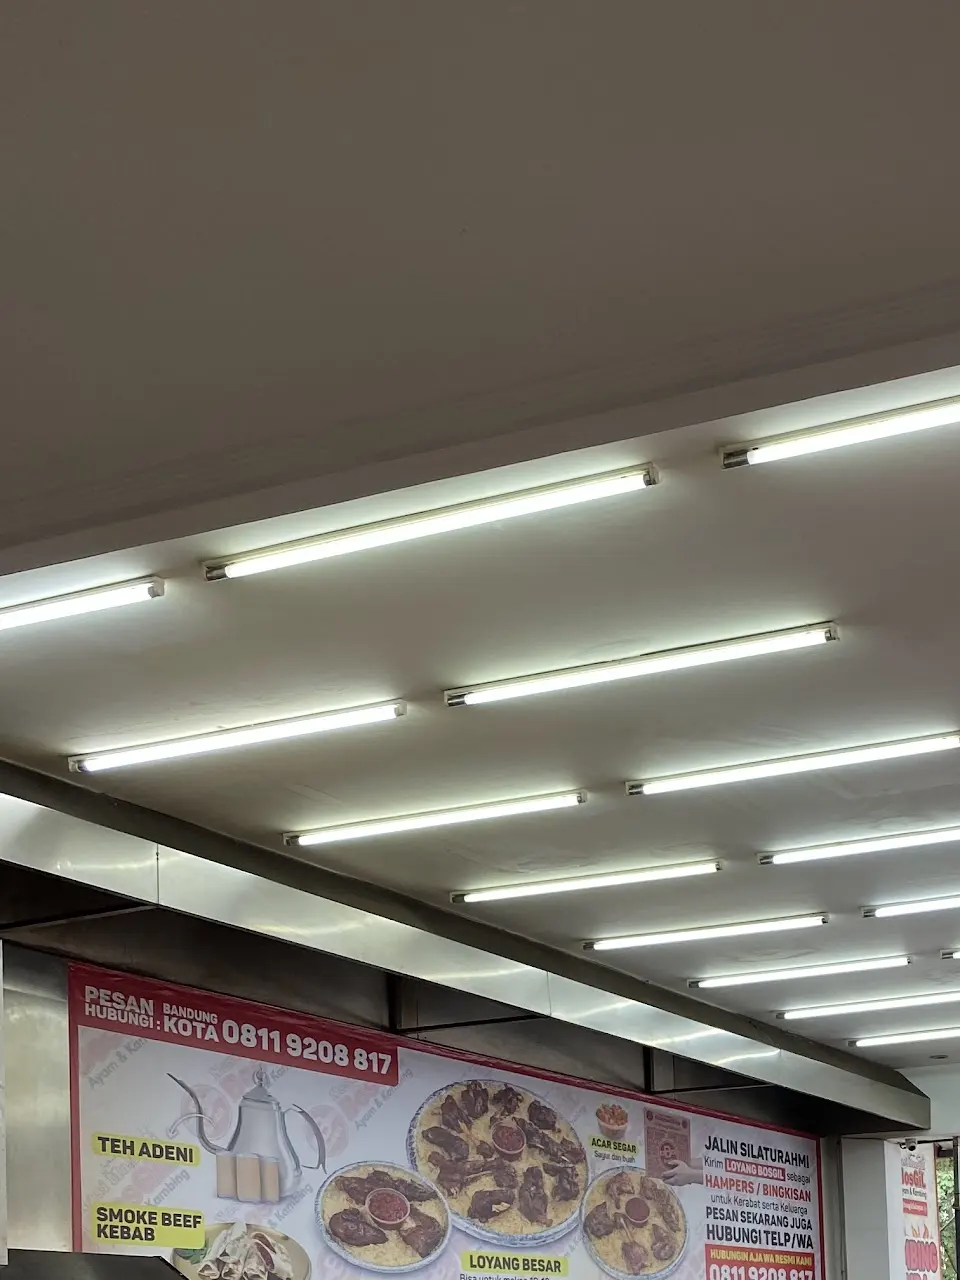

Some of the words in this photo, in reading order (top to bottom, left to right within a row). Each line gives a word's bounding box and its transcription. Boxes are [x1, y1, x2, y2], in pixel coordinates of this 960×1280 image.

[85, 986, 153, 1015] PESAN
[163, 1003, 218, 1024] BANDUNG
[85, 1003, 153, 1028] HUBUNGI
[164, 1016, 219, 1042] KOTA
[222, 1019, 280, 1052] 0811
[286, 1034, 349, 1067] 9208
[354, 1048, 392, 1075] 817
[98, 1136, 135, 1156] TEH
[138, 1142, 194, 1162] ADENI
[592, 1138, 612, 1150] ACAR
[612, 1141, 636, 1154] SEGAR
[704, 1136, 738, 1156] JALIN
[740, 1142, 810, 1168] SILATURAHMI
[704, 1156, 723, 1169] Kirim
[726, 1160, 756, 1174] LOYANG
[758, 1165, 784, 1180] BOSGIL
[787, 1172, 810, 1185] sebagai
[706, 1174, 754, 1194] HAMPERS
[763, 1184, 811, 1202] BINGKISAN
[96, 1207, 158, 1225] SMOKE
[162, 1213, 202, 1228] BEEF
[711, 1194, 732, 1205] untuk
[734, 1196, 760, 1209] Kerabat
[762, 1201, 779, 1212] serta
[780, 1204, 808, 1217] Keluarga
[706, 1206, 738, 1220] PESAN
[740, 1211, 788, 1227] SEKARANG
[790, 1219, 812, 1231] JUGA
[96, 1224, 155, 1241] KEBAB
[706, 1224, 762, 1244] HUBUNGI
[470, 1254, 520, 1270] LOYANG
[522, 1258, 562, 1272] BESAR
[710, 1249, 748, 1261] HUBUNGIN
[749, 1252, 764, 1262] AJA
[764, 1254, 774, 1264] WA
